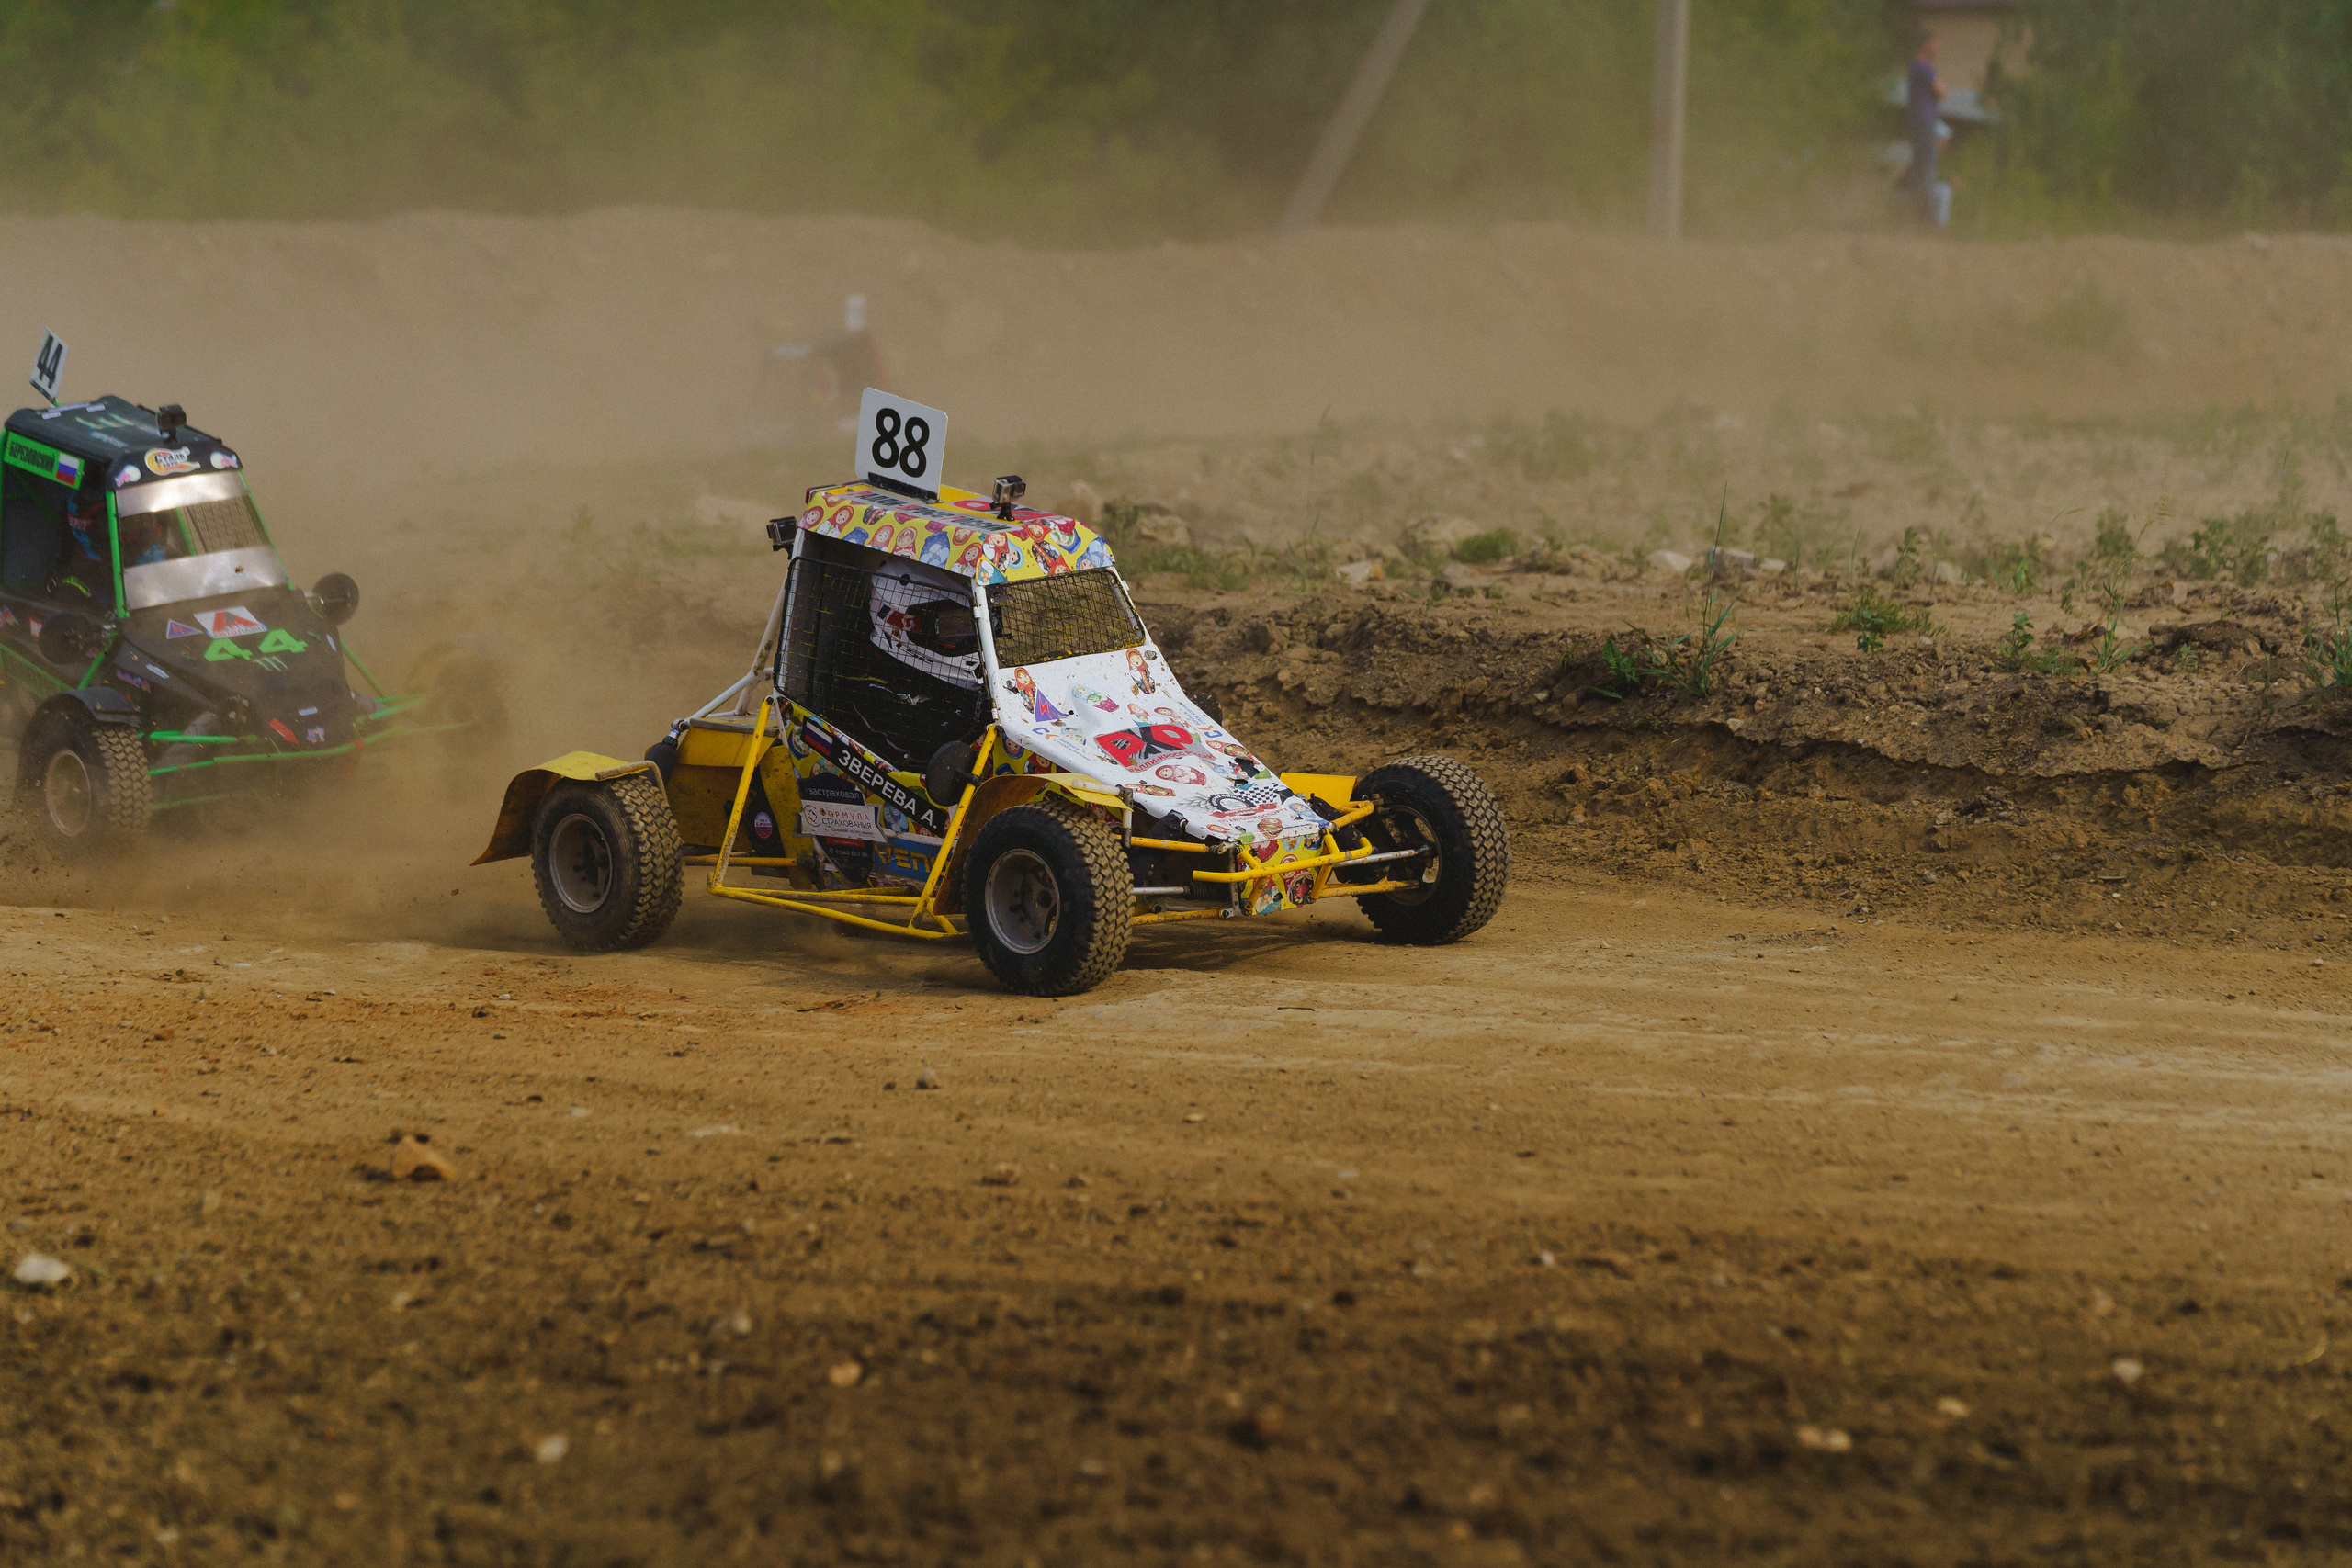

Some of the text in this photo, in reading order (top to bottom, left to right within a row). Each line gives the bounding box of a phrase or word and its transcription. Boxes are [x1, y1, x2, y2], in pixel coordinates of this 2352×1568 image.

[37, 334, 63, 389] 44
[872, 407, 930, 478] 88
[203, 627, 309, 662] 44
[838, 750, 937, 829] ЗВЕРЕВА А.
[820, 807, 870, 821] ФОРМУЛА
[821, 818, 873, 829] СТРАХОВАНИЯ
